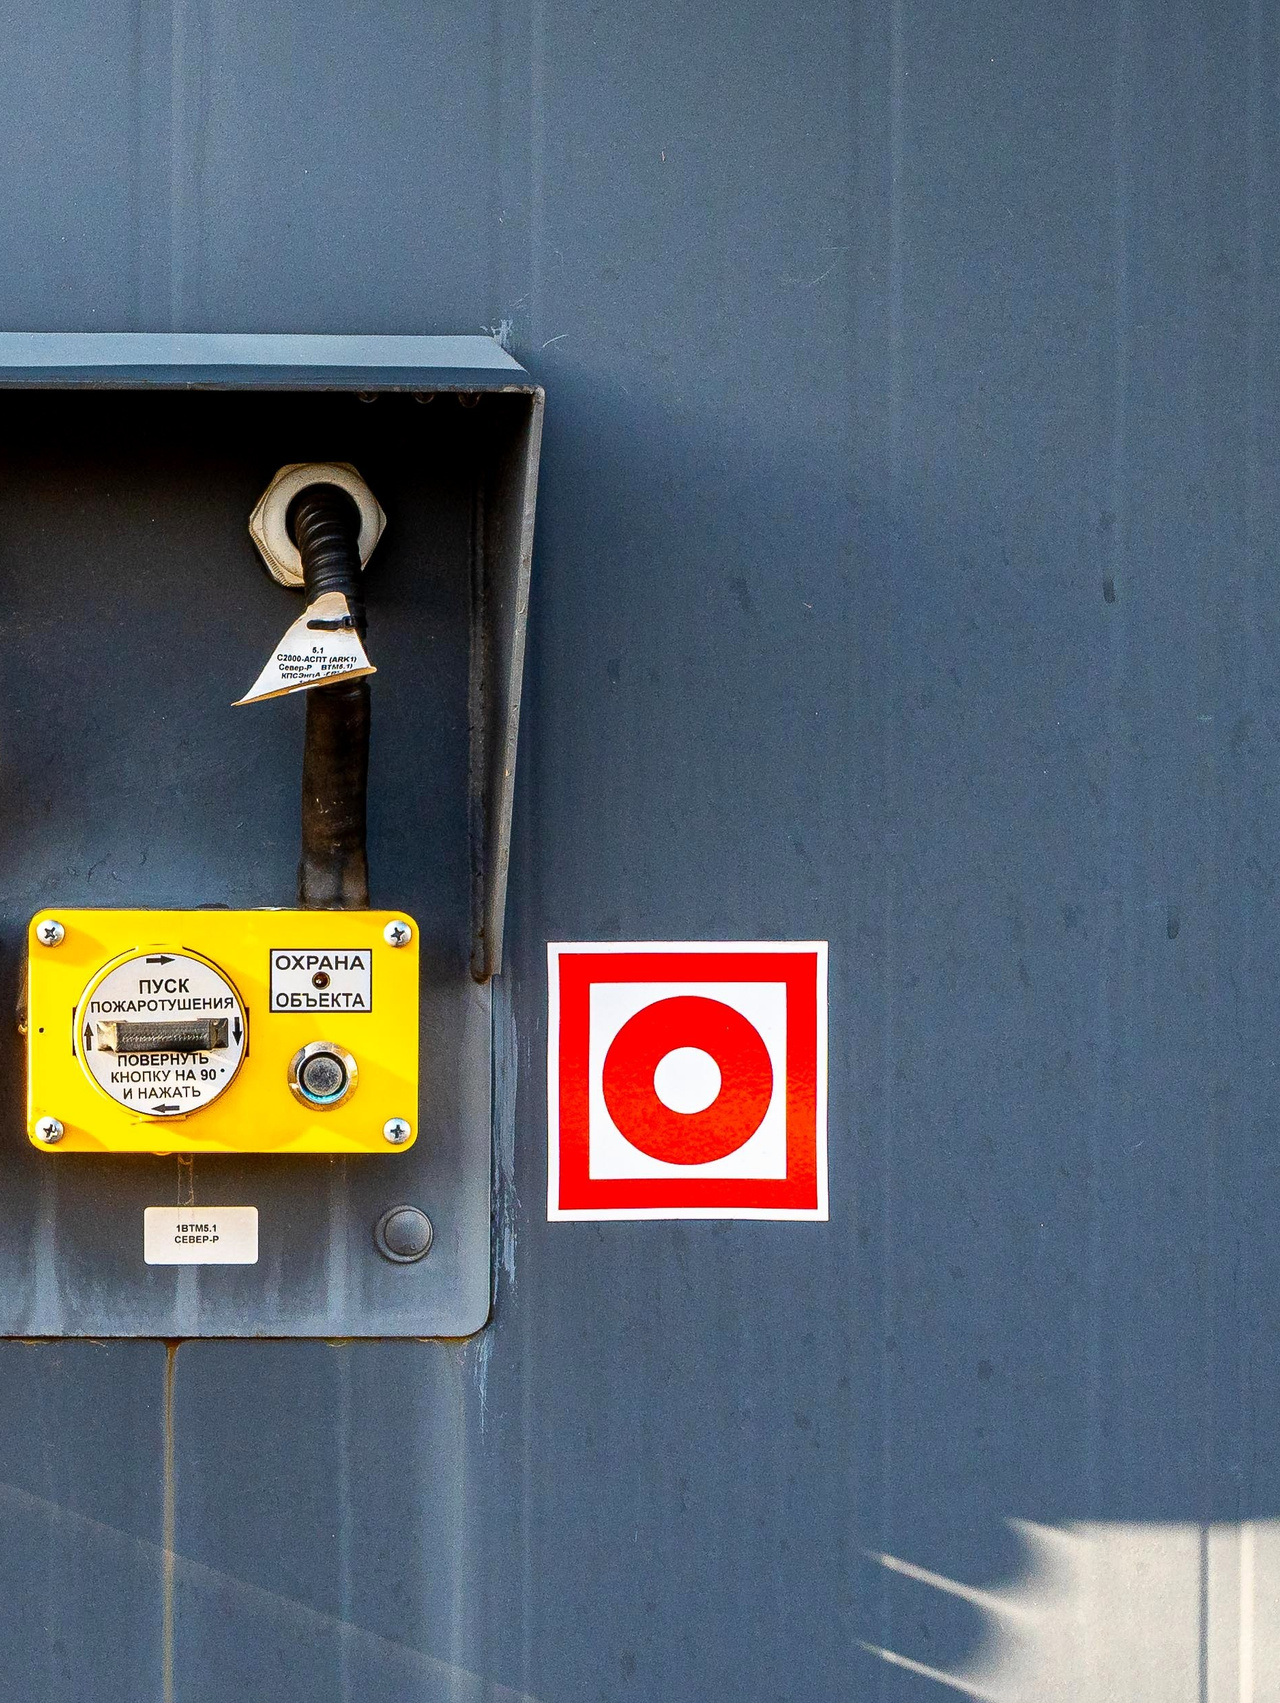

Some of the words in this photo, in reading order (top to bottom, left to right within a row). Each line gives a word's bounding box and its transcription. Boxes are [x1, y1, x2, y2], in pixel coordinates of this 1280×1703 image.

[278, 663, 313, 672] Север-Р
[275, 955, 365, 971] ОХРАНА
[139, 978, 190, 994] ПУСК
[91, 997, 234, 1013] ПОЖАРОТУШЕНИЯ
[276, 992, 365, 1008] ОБЪЕКТА
[118, 1053, 209, 1067] ПОВЕРНУТЬ
[111, 1070, 171, 1083] КНОПКУ
[175, 1069, 197, 1081] НА
[123, 1087, 133, 1100] И
[138, 1085, 201, 1099] НАЖАТЬ
[174, 1235, 219, 1244] СЕВЕР-Р
